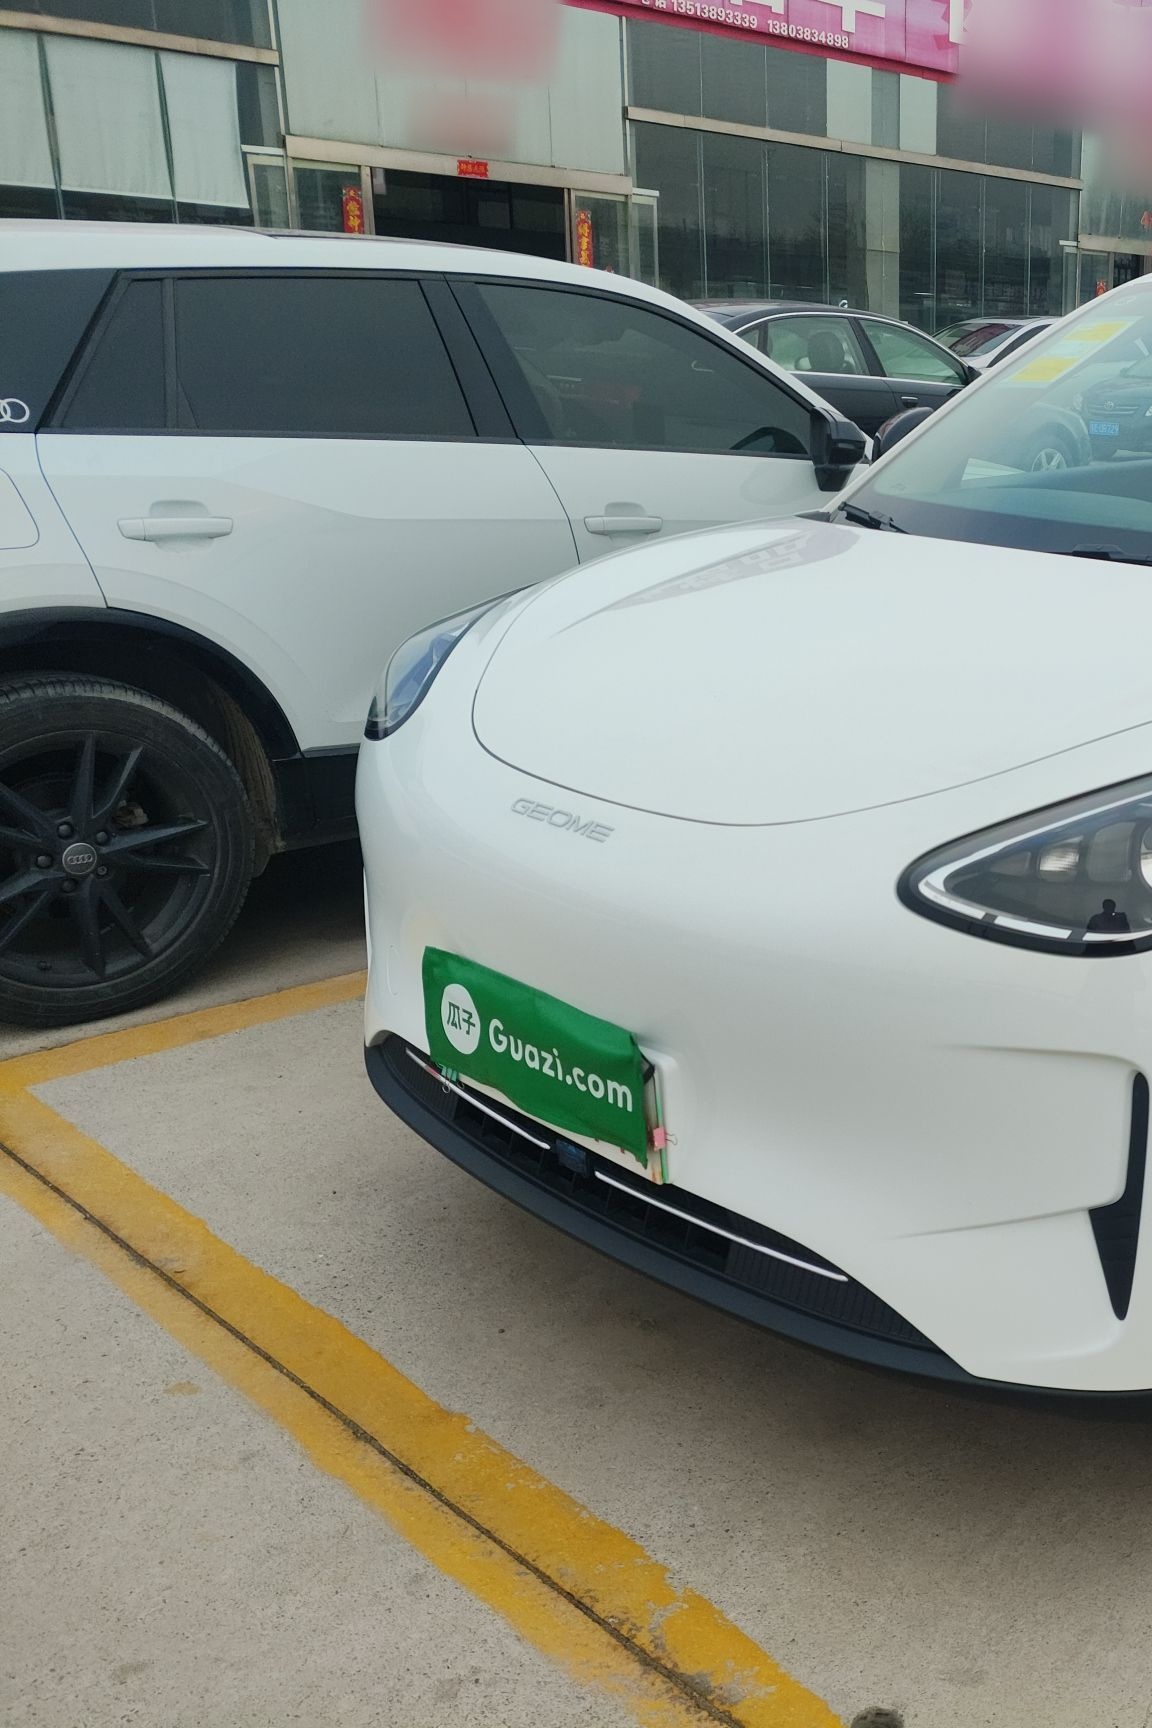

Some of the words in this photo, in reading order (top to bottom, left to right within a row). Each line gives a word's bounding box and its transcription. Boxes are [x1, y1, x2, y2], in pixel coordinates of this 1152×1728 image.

[671, 0, 758, 29] 13513893339
[767, 19, 849, 49] 13803834898
[511, 798, 616, 843] GEOME
[447, 1001, 476, 1035] 瓜子
[489, 1018, 633, 1113] Guazi.com
